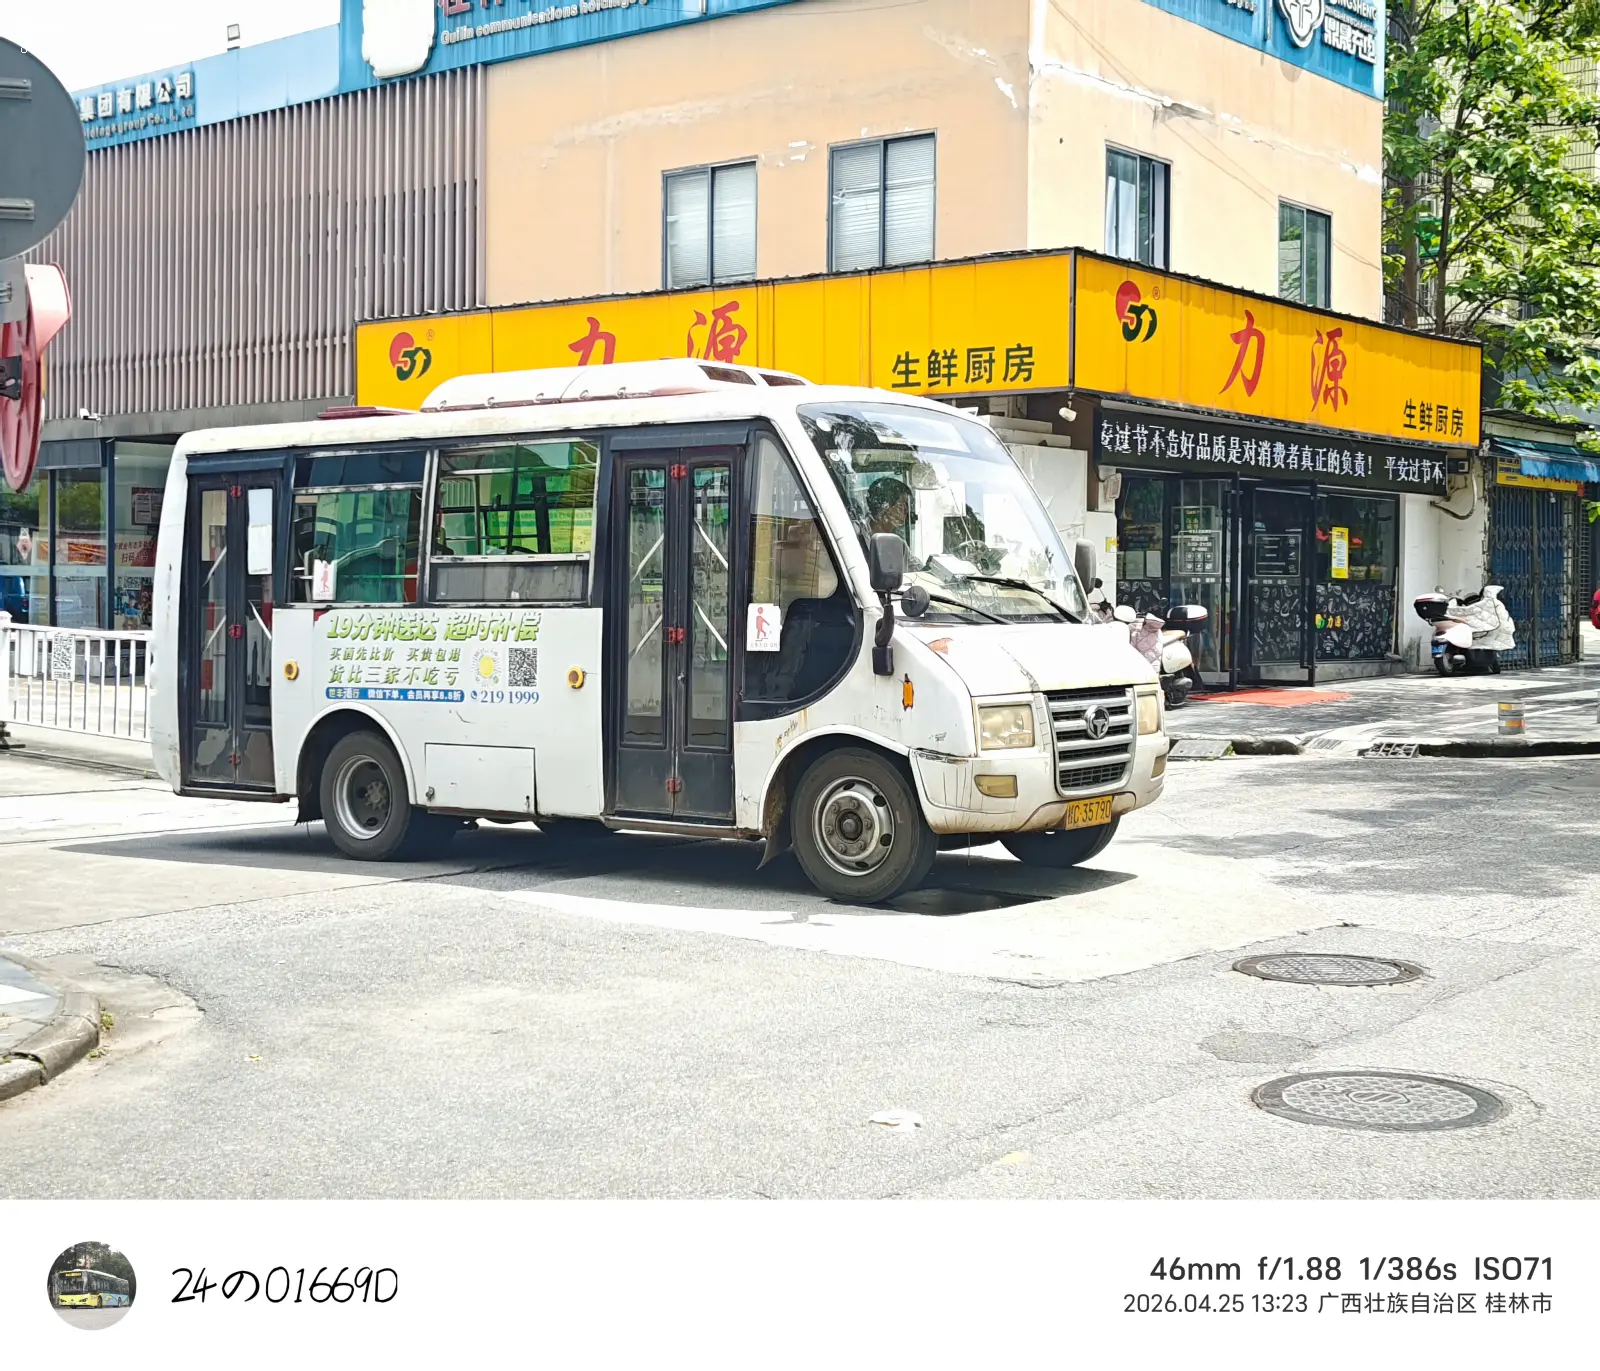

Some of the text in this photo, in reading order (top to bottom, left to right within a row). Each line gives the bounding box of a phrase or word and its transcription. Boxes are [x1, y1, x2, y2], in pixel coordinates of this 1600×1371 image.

[441, 26, 474, 45] Guilin
[476, 4, 578, 37] communications
[80, 73, 194, 122] 集团有限公司
[568, 300, 748, 366] 力源
[891, 343, 1035, 388] 生鲜厨房
[1219, 310, 1348, 412] 力源
[1403, 399, 1464, 437] 生鲜厨房
[326, 611, 541, 641] 19分钟送达 超时补偿
[329, 664, 460, 685] 货比三家不吃亏
[481, 690, 540, 704] 219 1999
